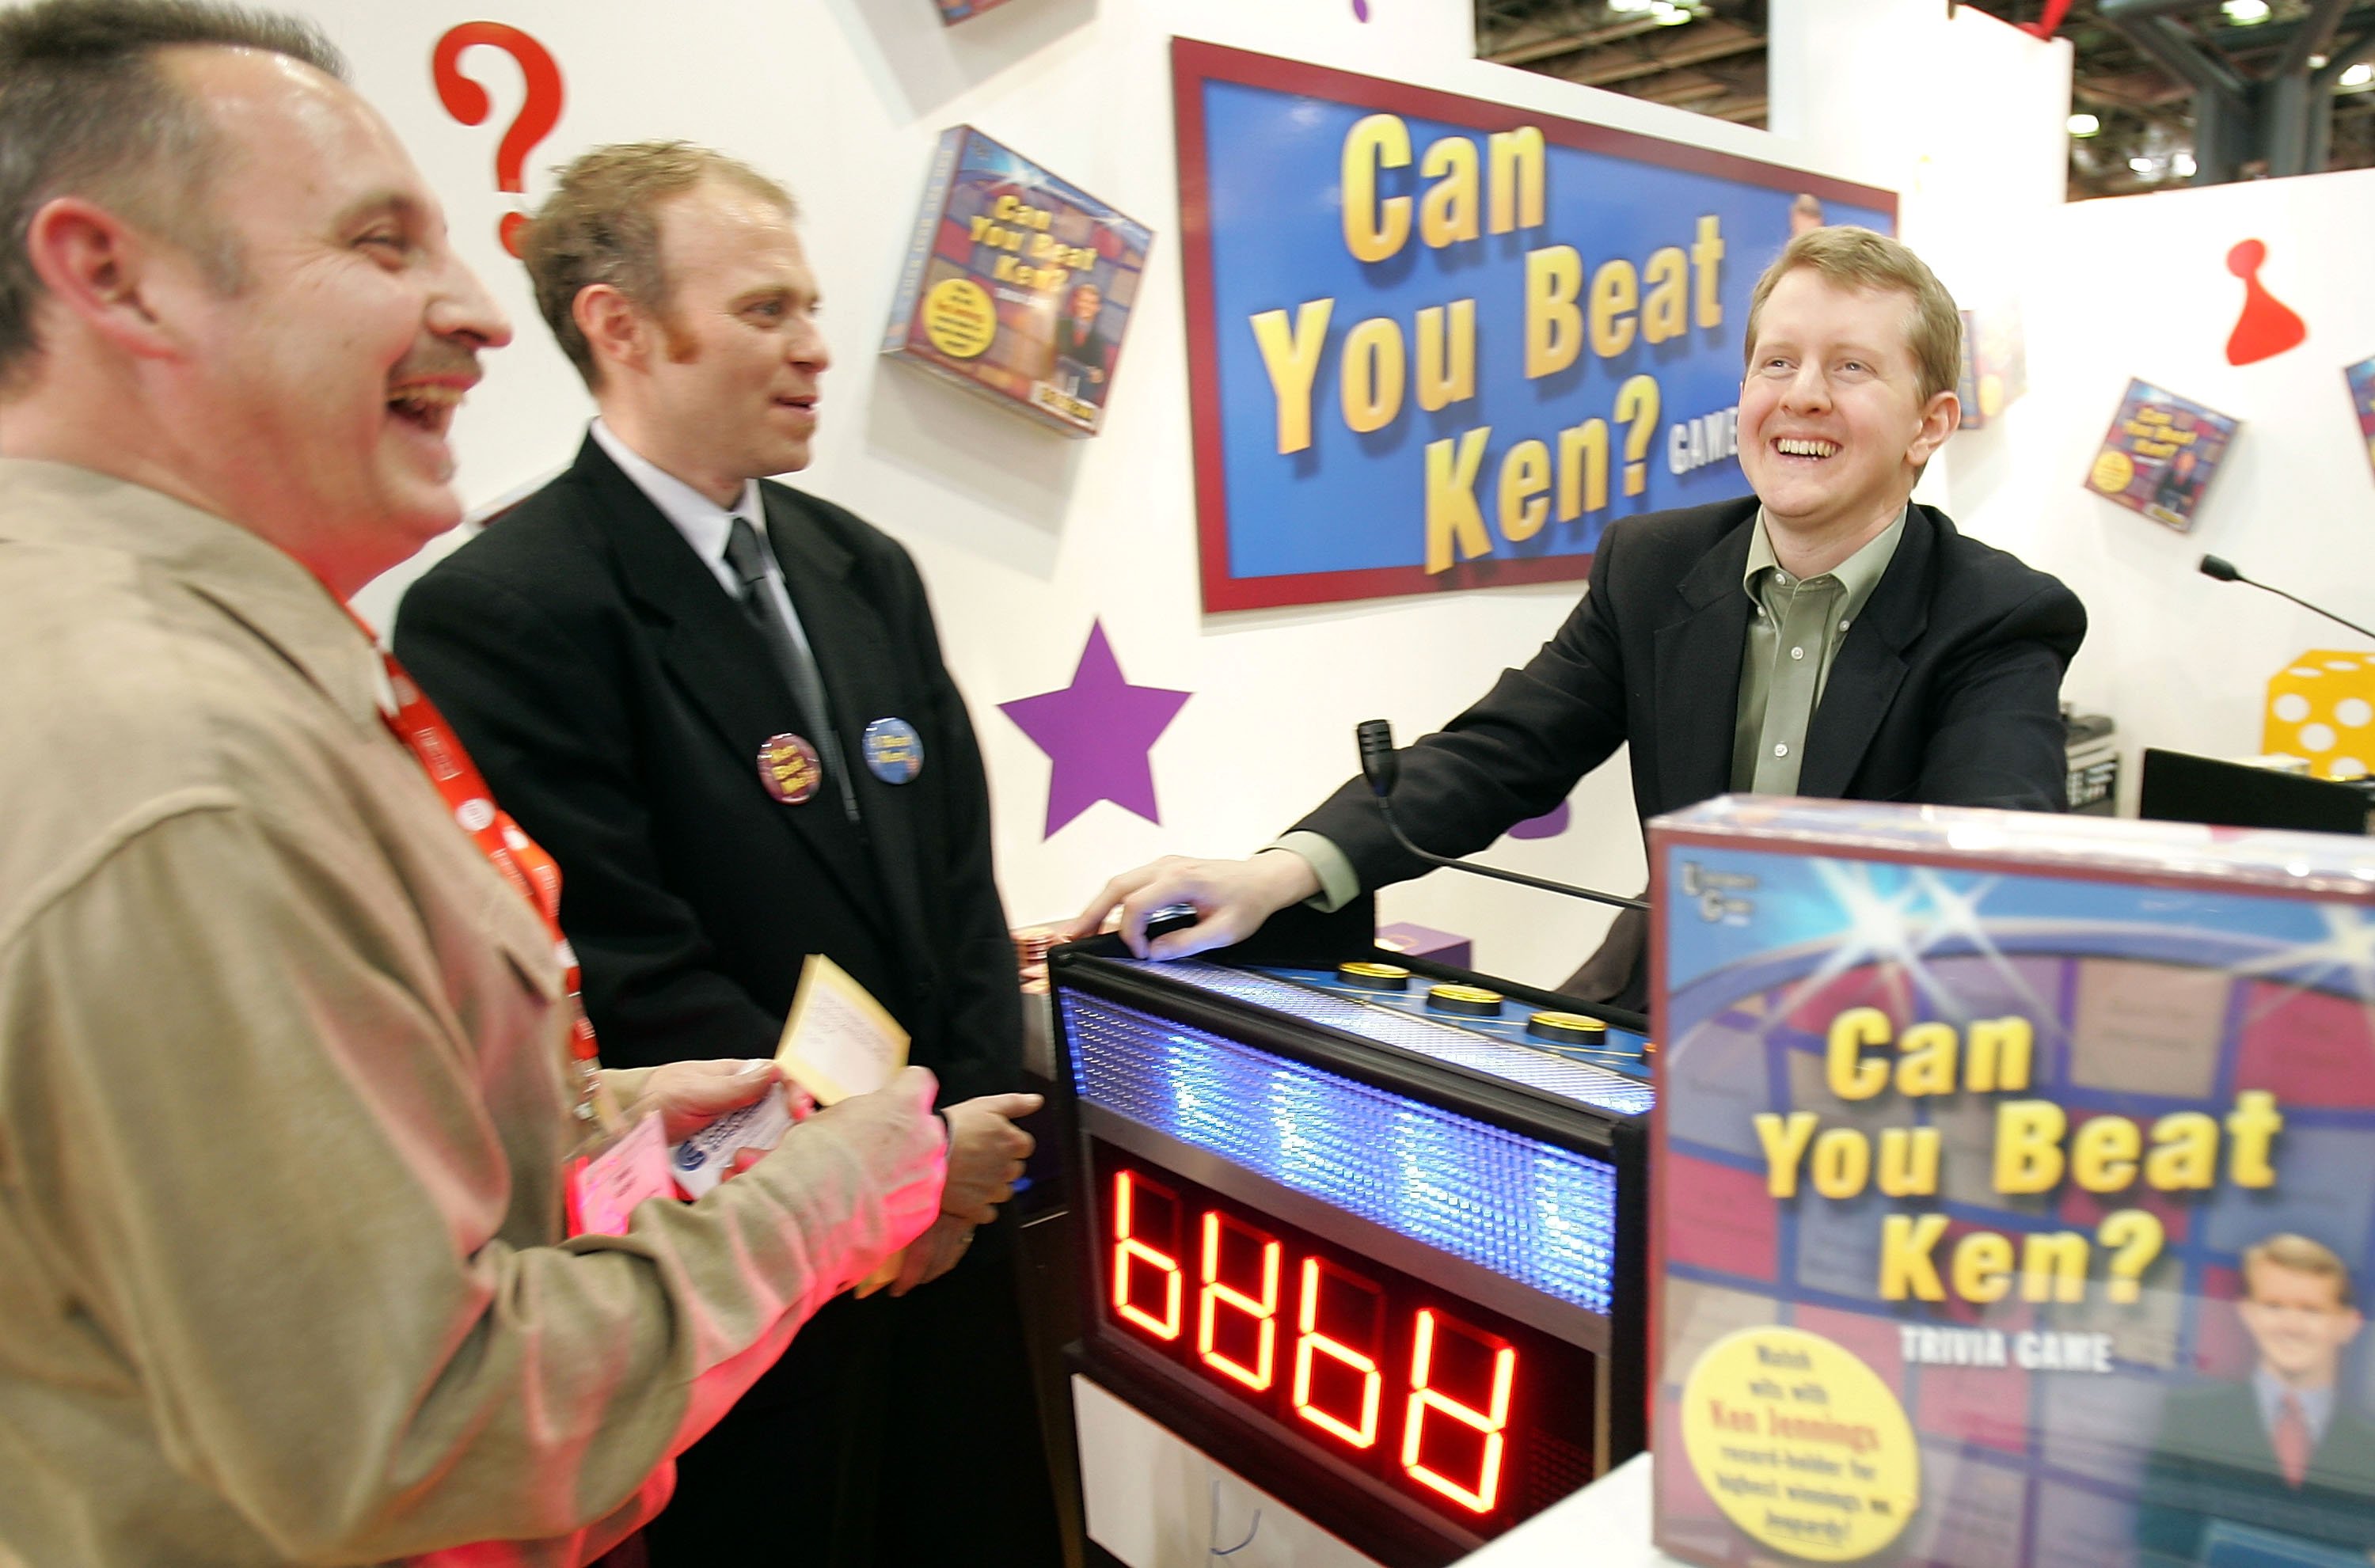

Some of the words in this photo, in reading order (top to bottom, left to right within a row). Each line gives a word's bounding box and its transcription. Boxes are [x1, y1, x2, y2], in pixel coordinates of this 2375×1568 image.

[1340, 112, 1546, 264] Can
[1250, 298, 1476, 455] You
[1526, 215, 1723, 380] Beat
[1425, 374, 1660, 576] Ken?
[1826, 1007, 2033, 1101] Can
[1754, 1111, 1941, 1199] You
[1992, 1090, 2283, 1194] Beat
[1879, 1209, 2164, 1304] Ken?
[1901, 1326, 2008, 1368] TRIVIA
[2013, 1331, 2113, 1374] GAME
[1708, 1398, 1758, 1435] Ken
